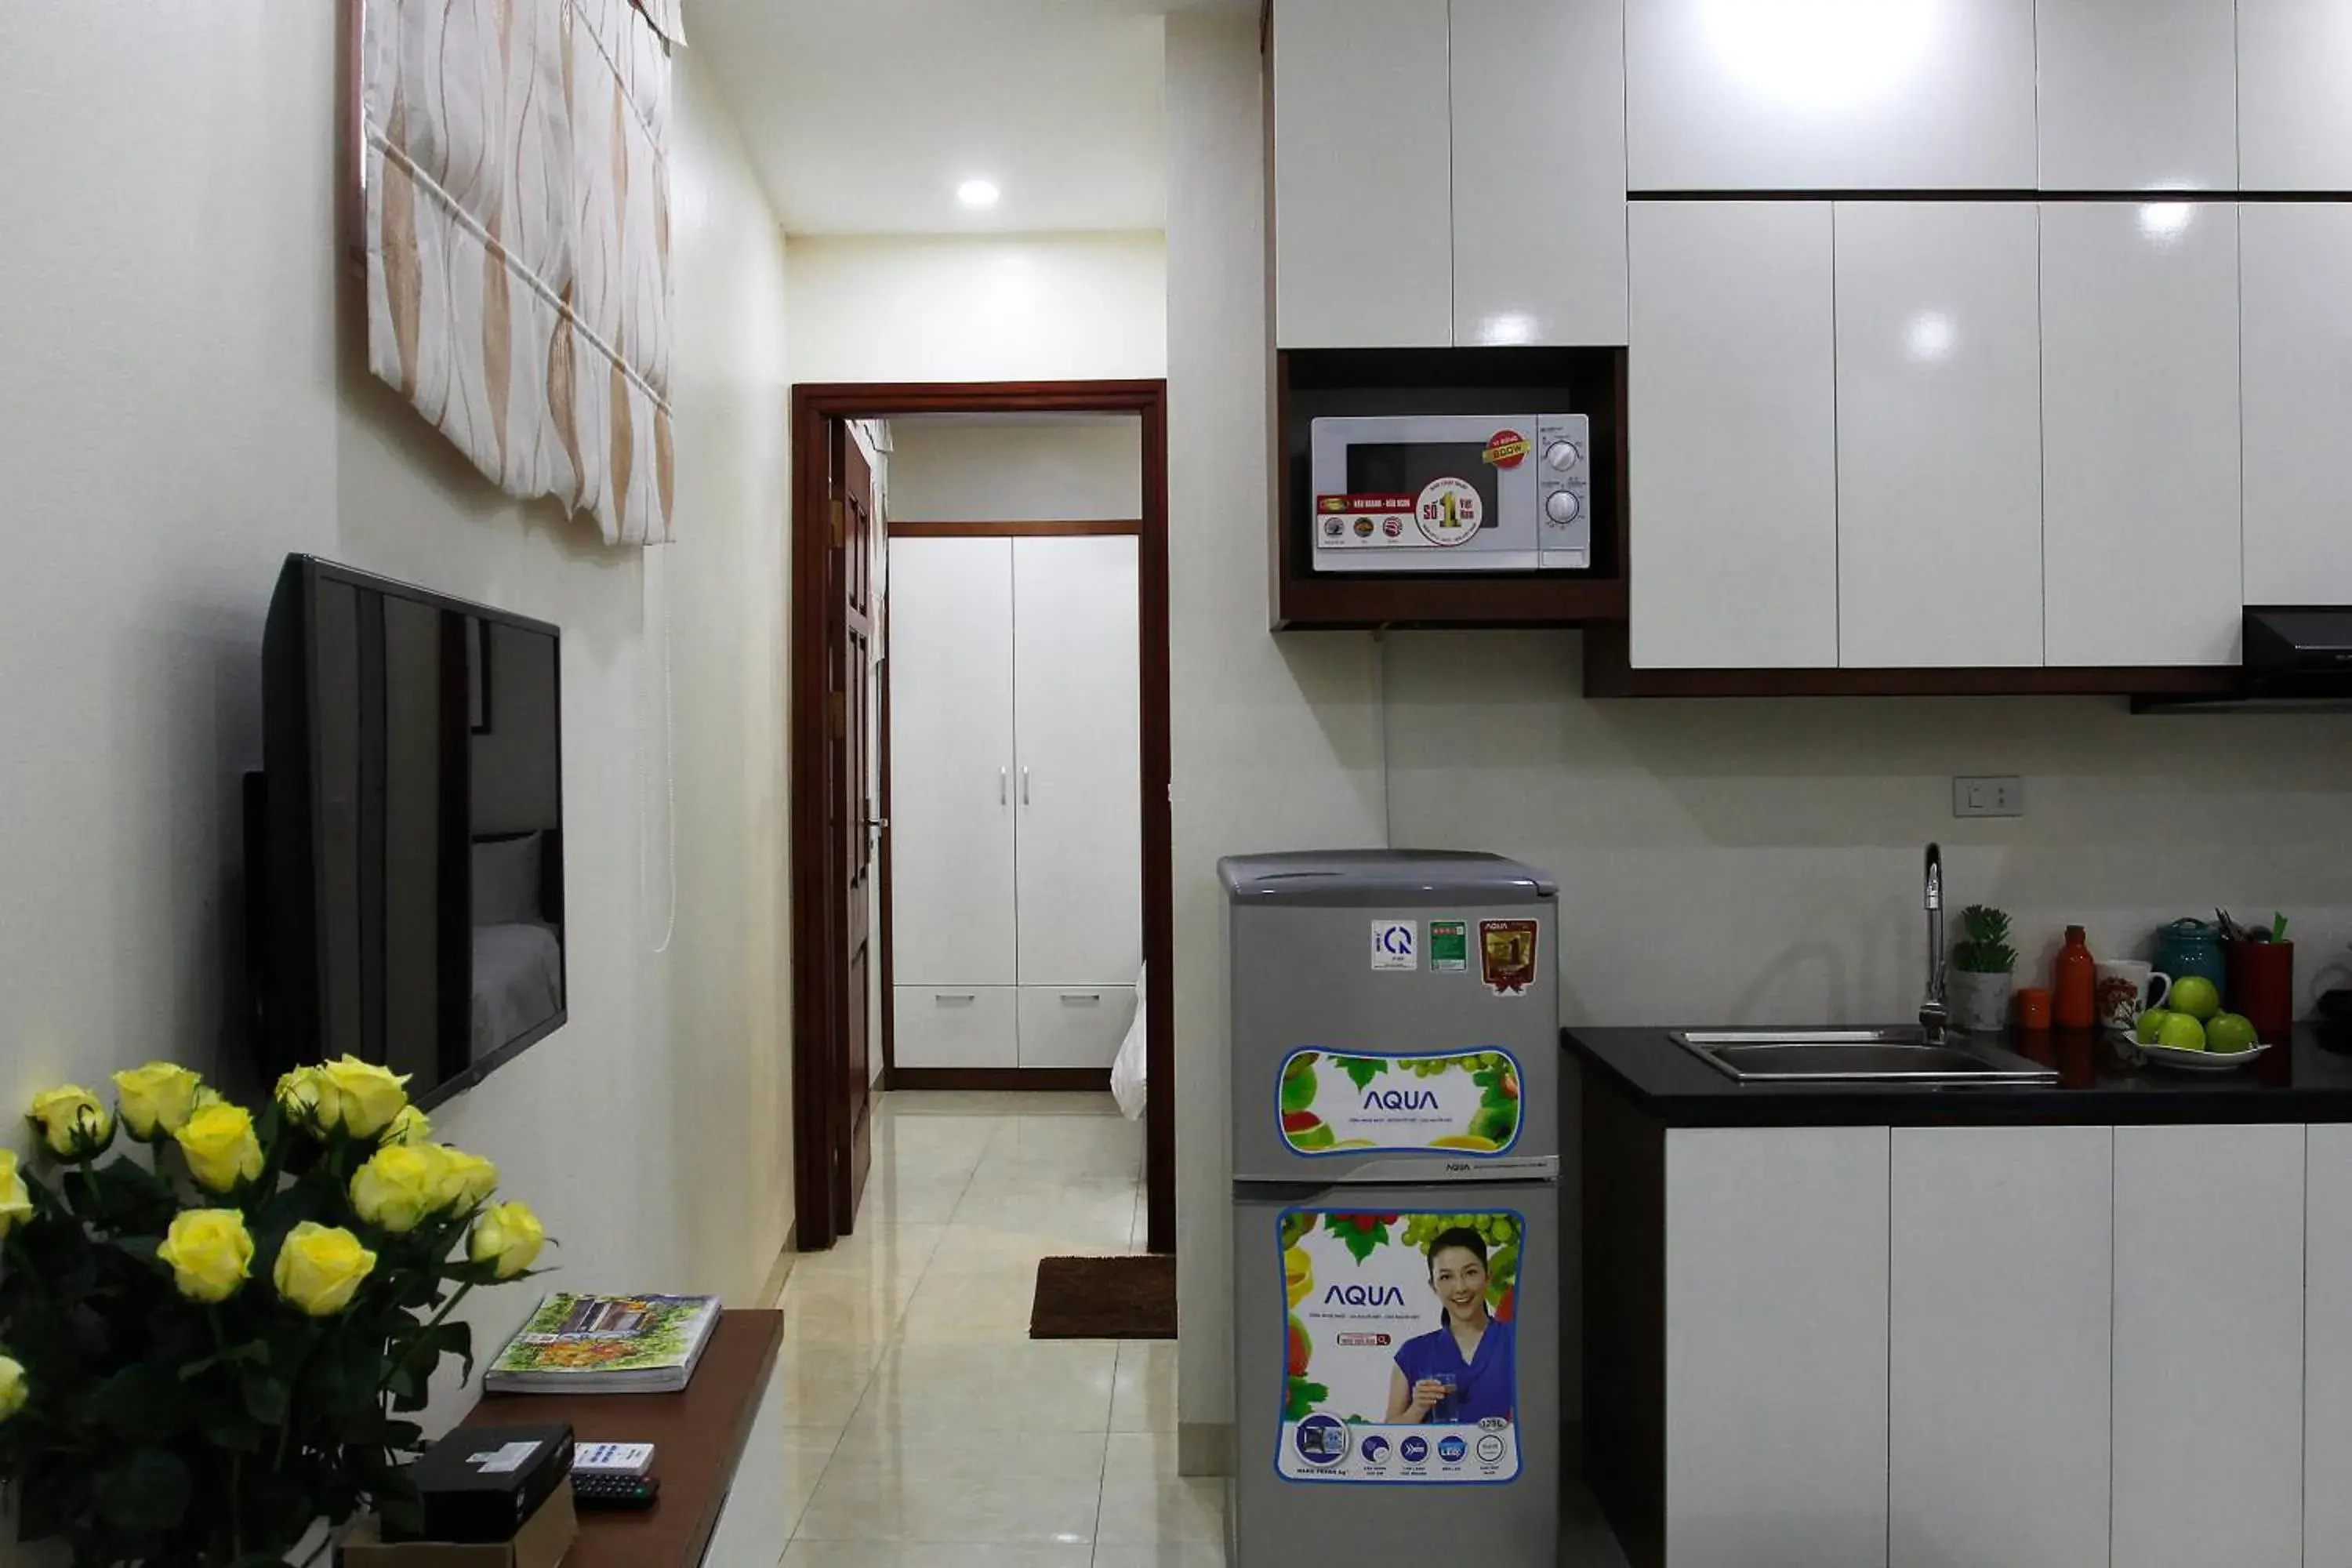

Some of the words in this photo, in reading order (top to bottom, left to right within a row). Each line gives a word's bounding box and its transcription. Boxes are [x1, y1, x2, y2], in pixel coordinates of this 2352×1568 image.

[1439, 491, 1461, 527] 1
[1363, 1091, 1439, 1109] AQUA
[1324, 1285, 1405, 1306] AQUA
